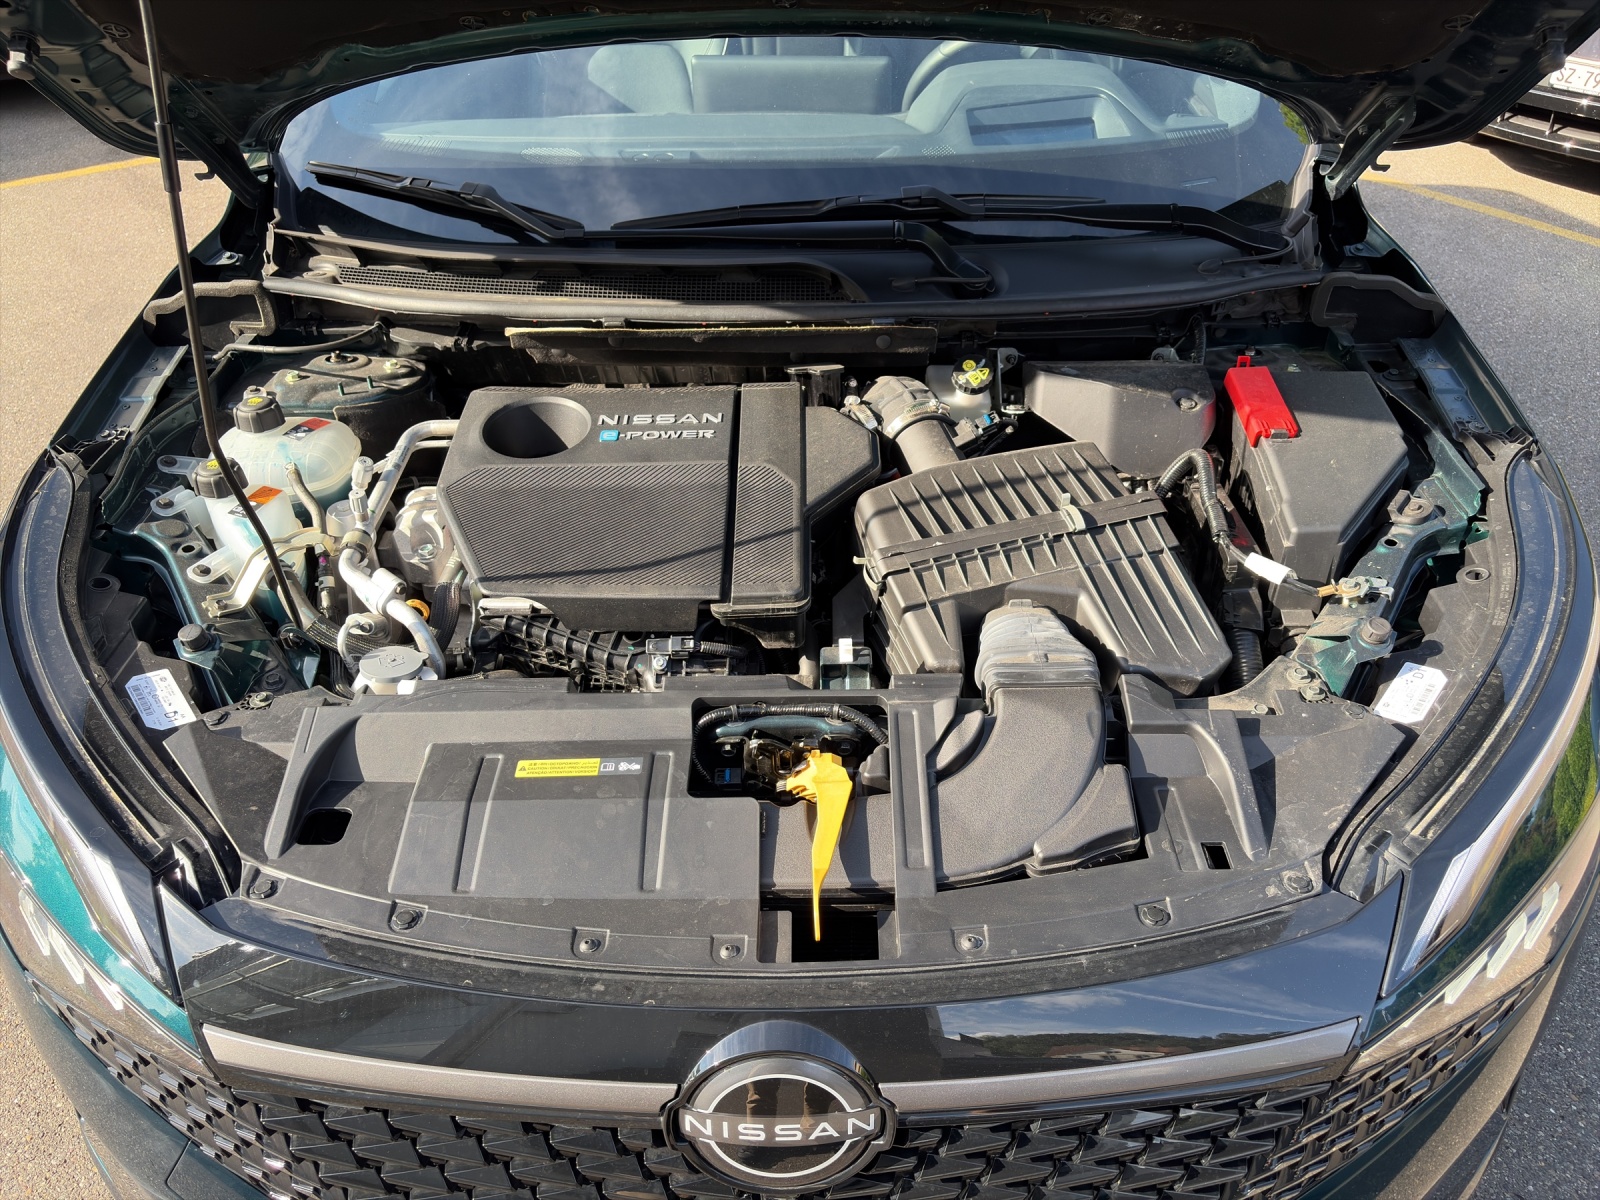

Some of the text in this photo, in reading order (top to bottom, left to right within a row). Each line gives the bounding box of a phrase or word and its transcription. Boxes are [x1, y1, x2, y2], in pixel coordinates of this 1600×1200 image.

[597, 412, 723, 426] NISSAN
[600, 429, 716, 442] e-POWER
[684, 1113, 875, 1141] NISSAN
